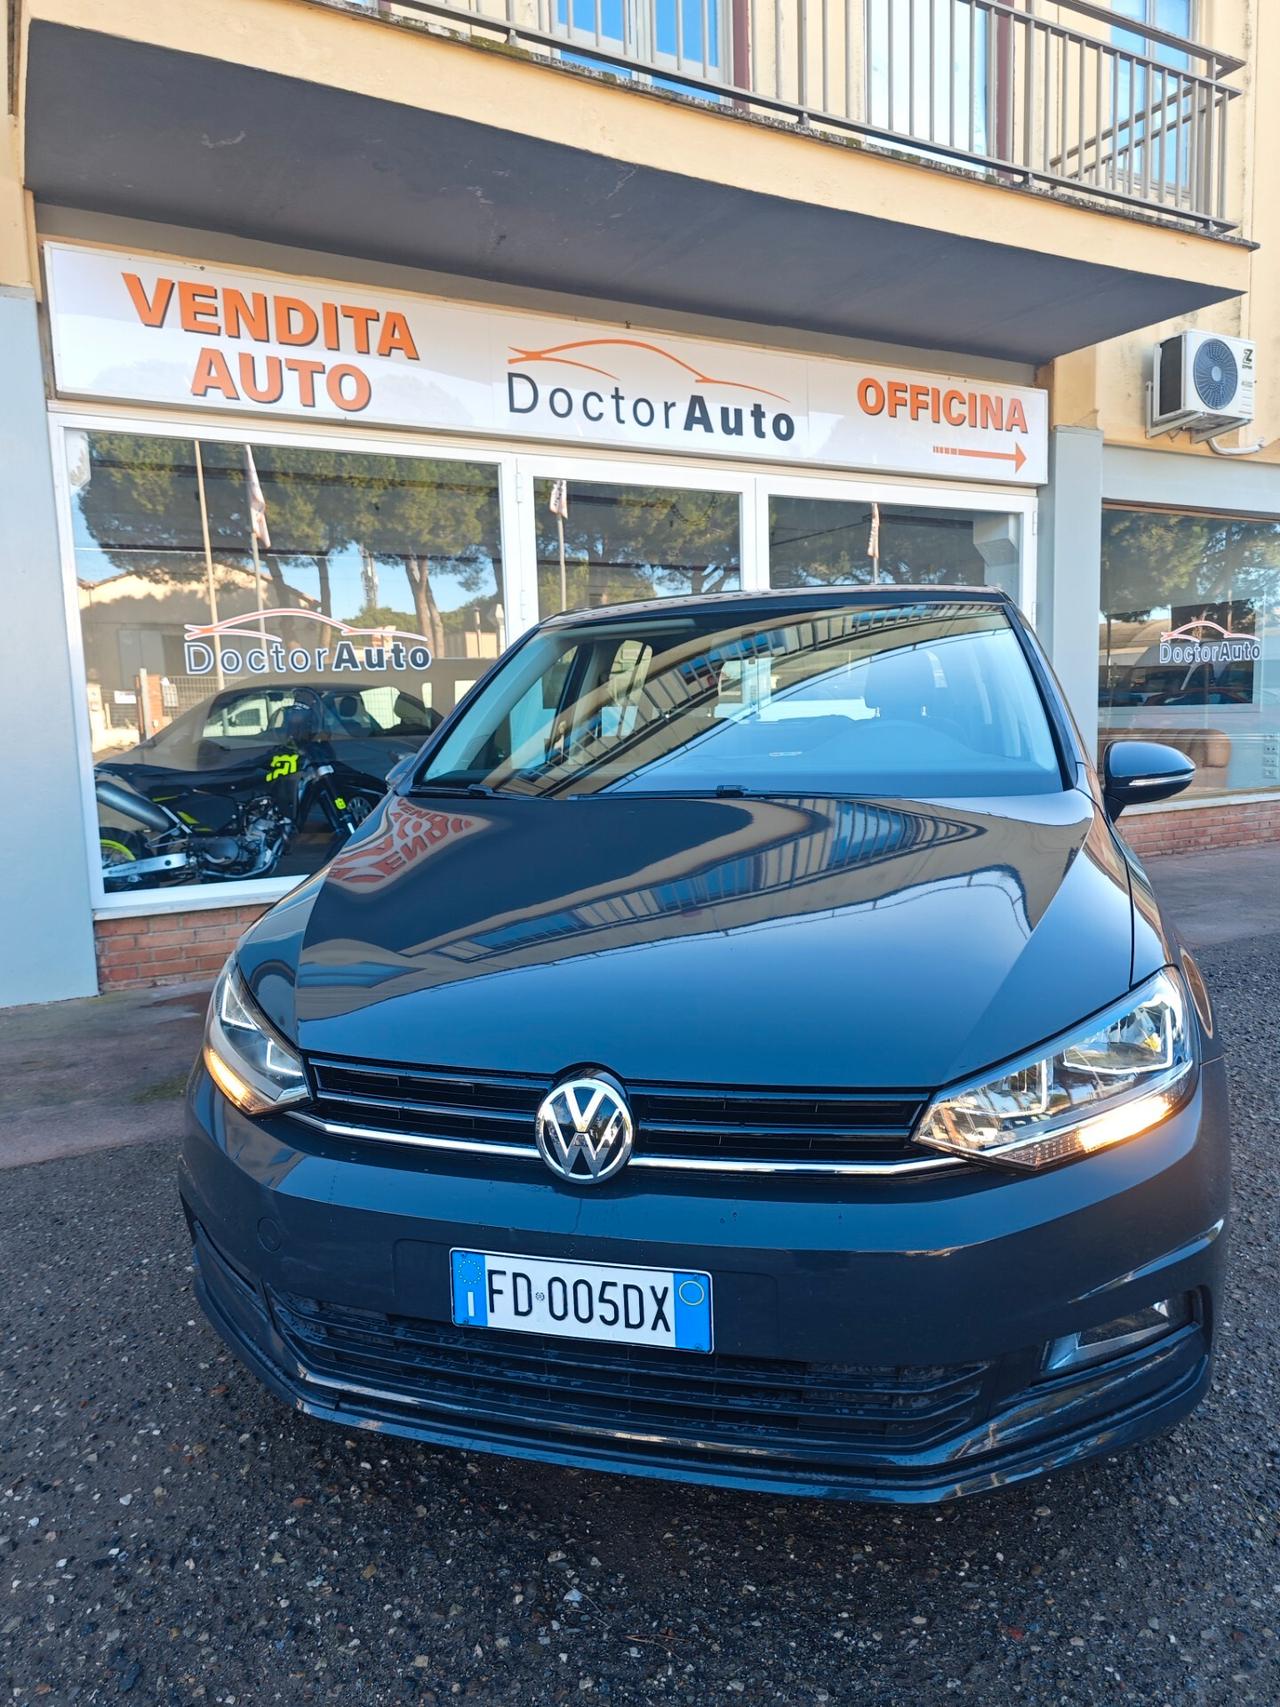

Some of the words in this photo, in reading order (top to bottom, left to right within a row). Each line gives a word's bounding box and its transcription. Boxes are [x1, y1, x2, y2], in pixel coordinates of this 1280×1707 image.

[121, 272, 421, 361] VENDITA
[190, 347, 373, 412] AUTO
[507, 371, 796, 442] DoctorAuto
[856, 377, 1029, 434] OFFICINA
[183, 640, 433, 675] DoctorAuto
[1159, 640, 1262, 664] DoctorAuto
